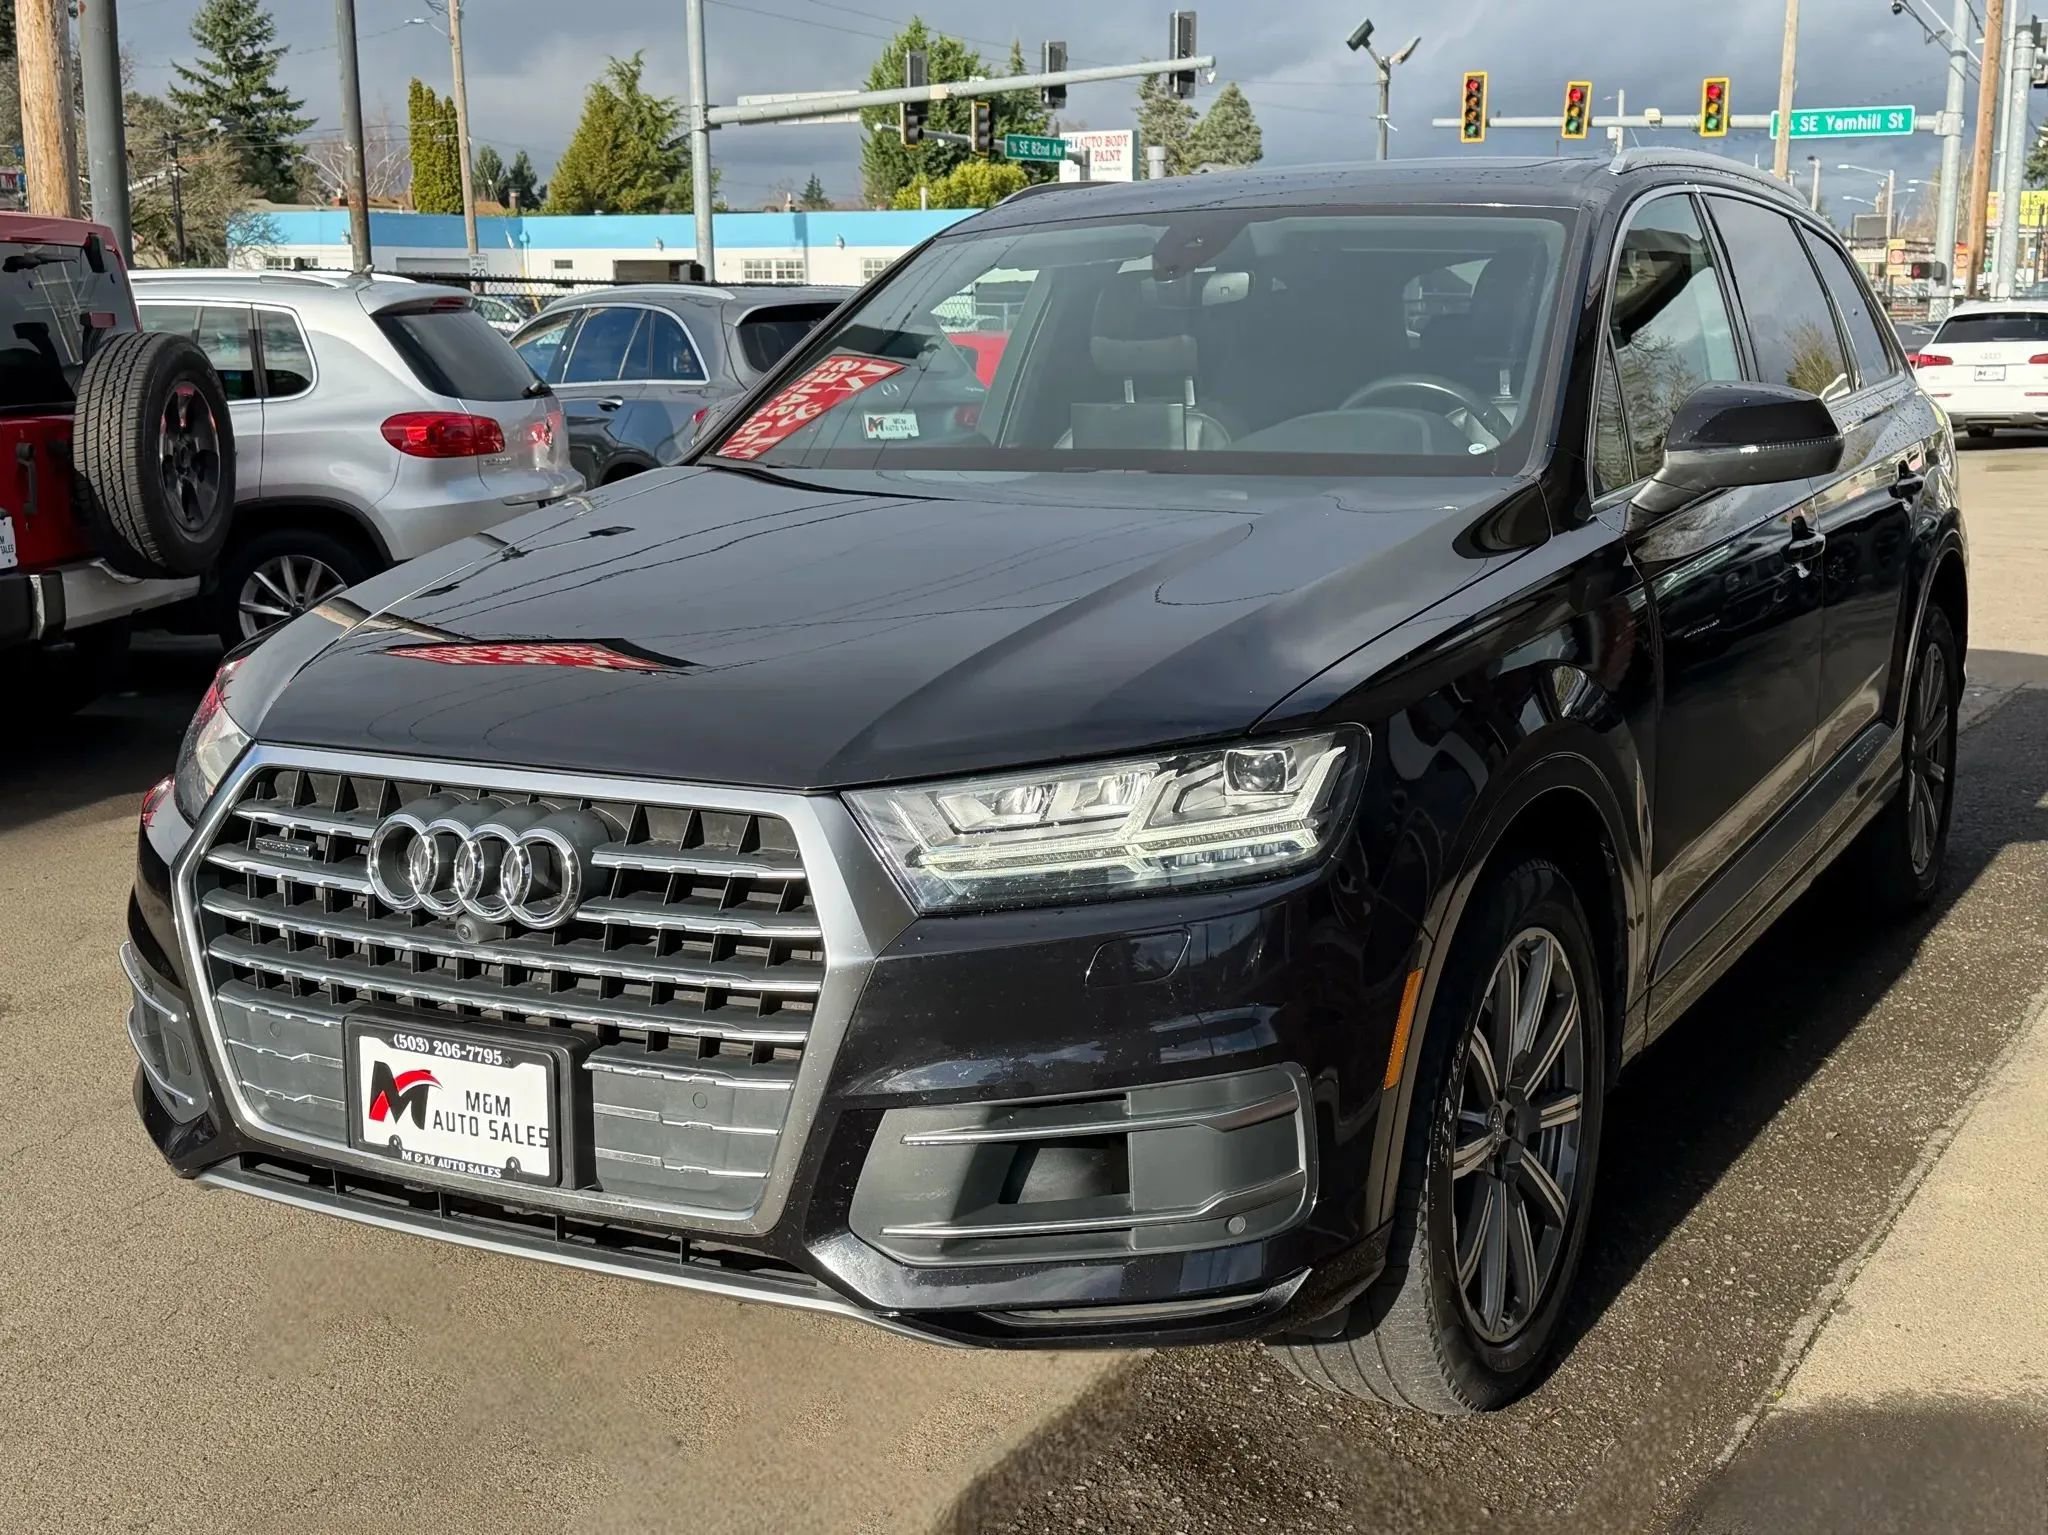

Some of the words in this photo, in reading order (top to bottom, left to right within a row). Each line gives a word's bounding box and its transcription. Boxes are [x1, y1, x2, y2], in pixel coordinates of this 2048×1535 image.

[1800, 116, 1818, 132] SE
[1826, 114, 1881, 130] Yamhill
[1888, 112, 1904, 128] St
[1019, 139, 1029, 154] SE
[1032, 141, 1050, 156] 82nd
[1052, 142, 1062, 156] Av
[1080, 136, 1102, 148] AUTO
[1104, 135, 1128, 147] BODY
[1094, 150, 1121, 162] PAINT
[393, 1033, 429, 1053] (503)
[433, 1040, 503, 1065] 206-7795
[465, 1090, 511, 1118] M&M
[433, 1110, 479, 1136] AUTO
[489, 1120, 549, 1148] SALES
[401, 1150, 412, 1160] M
[414, 1153, 423, 1162] &
[424, 1155, 436, 1166] M
[437, 1158, 465, 1172] AUTO
[468, 1162, 502, 1178] SALES
